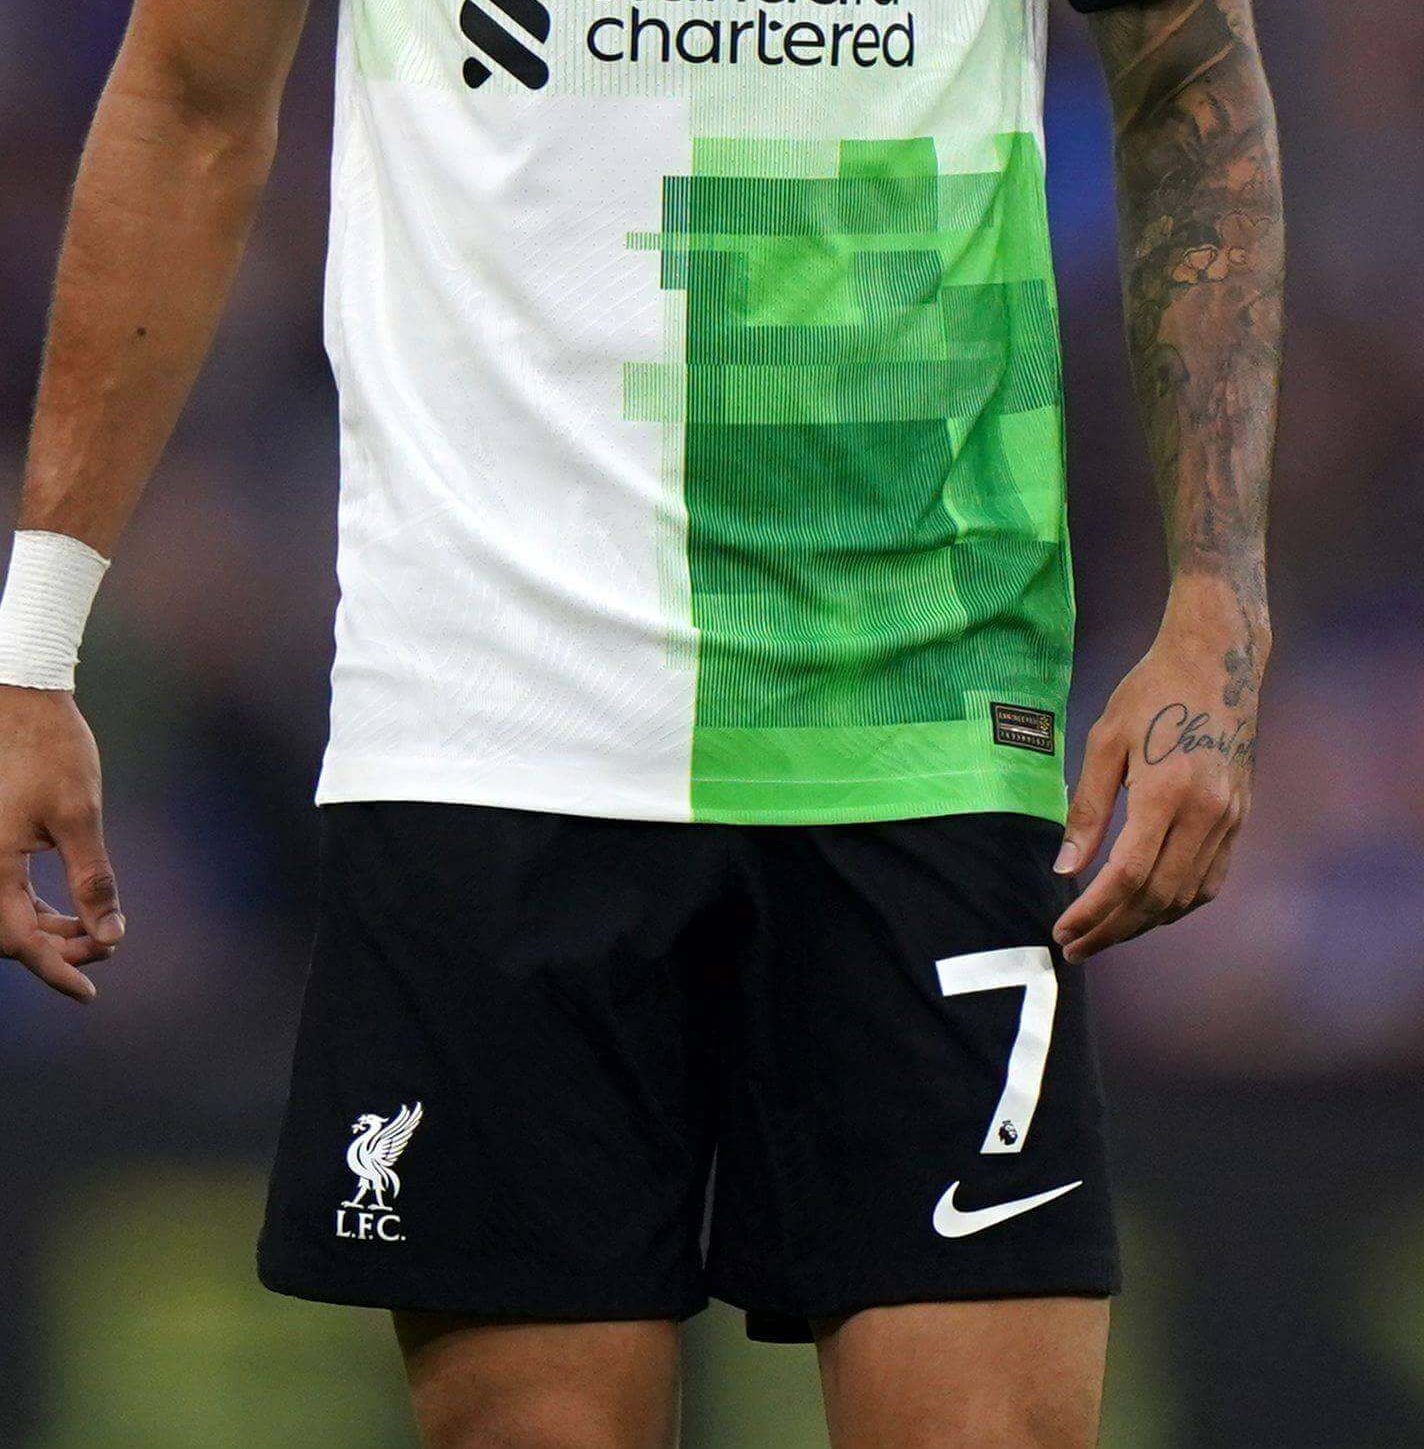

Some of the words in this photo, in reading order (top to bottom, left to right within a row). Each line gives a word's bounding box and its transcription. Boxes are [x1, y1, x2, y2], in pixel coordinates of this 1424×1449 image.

[587, 6, 913, 67] chartered
[935, 946, 1058, 1154] 7
[335, 1210, 406, 1241] L.F.C.
